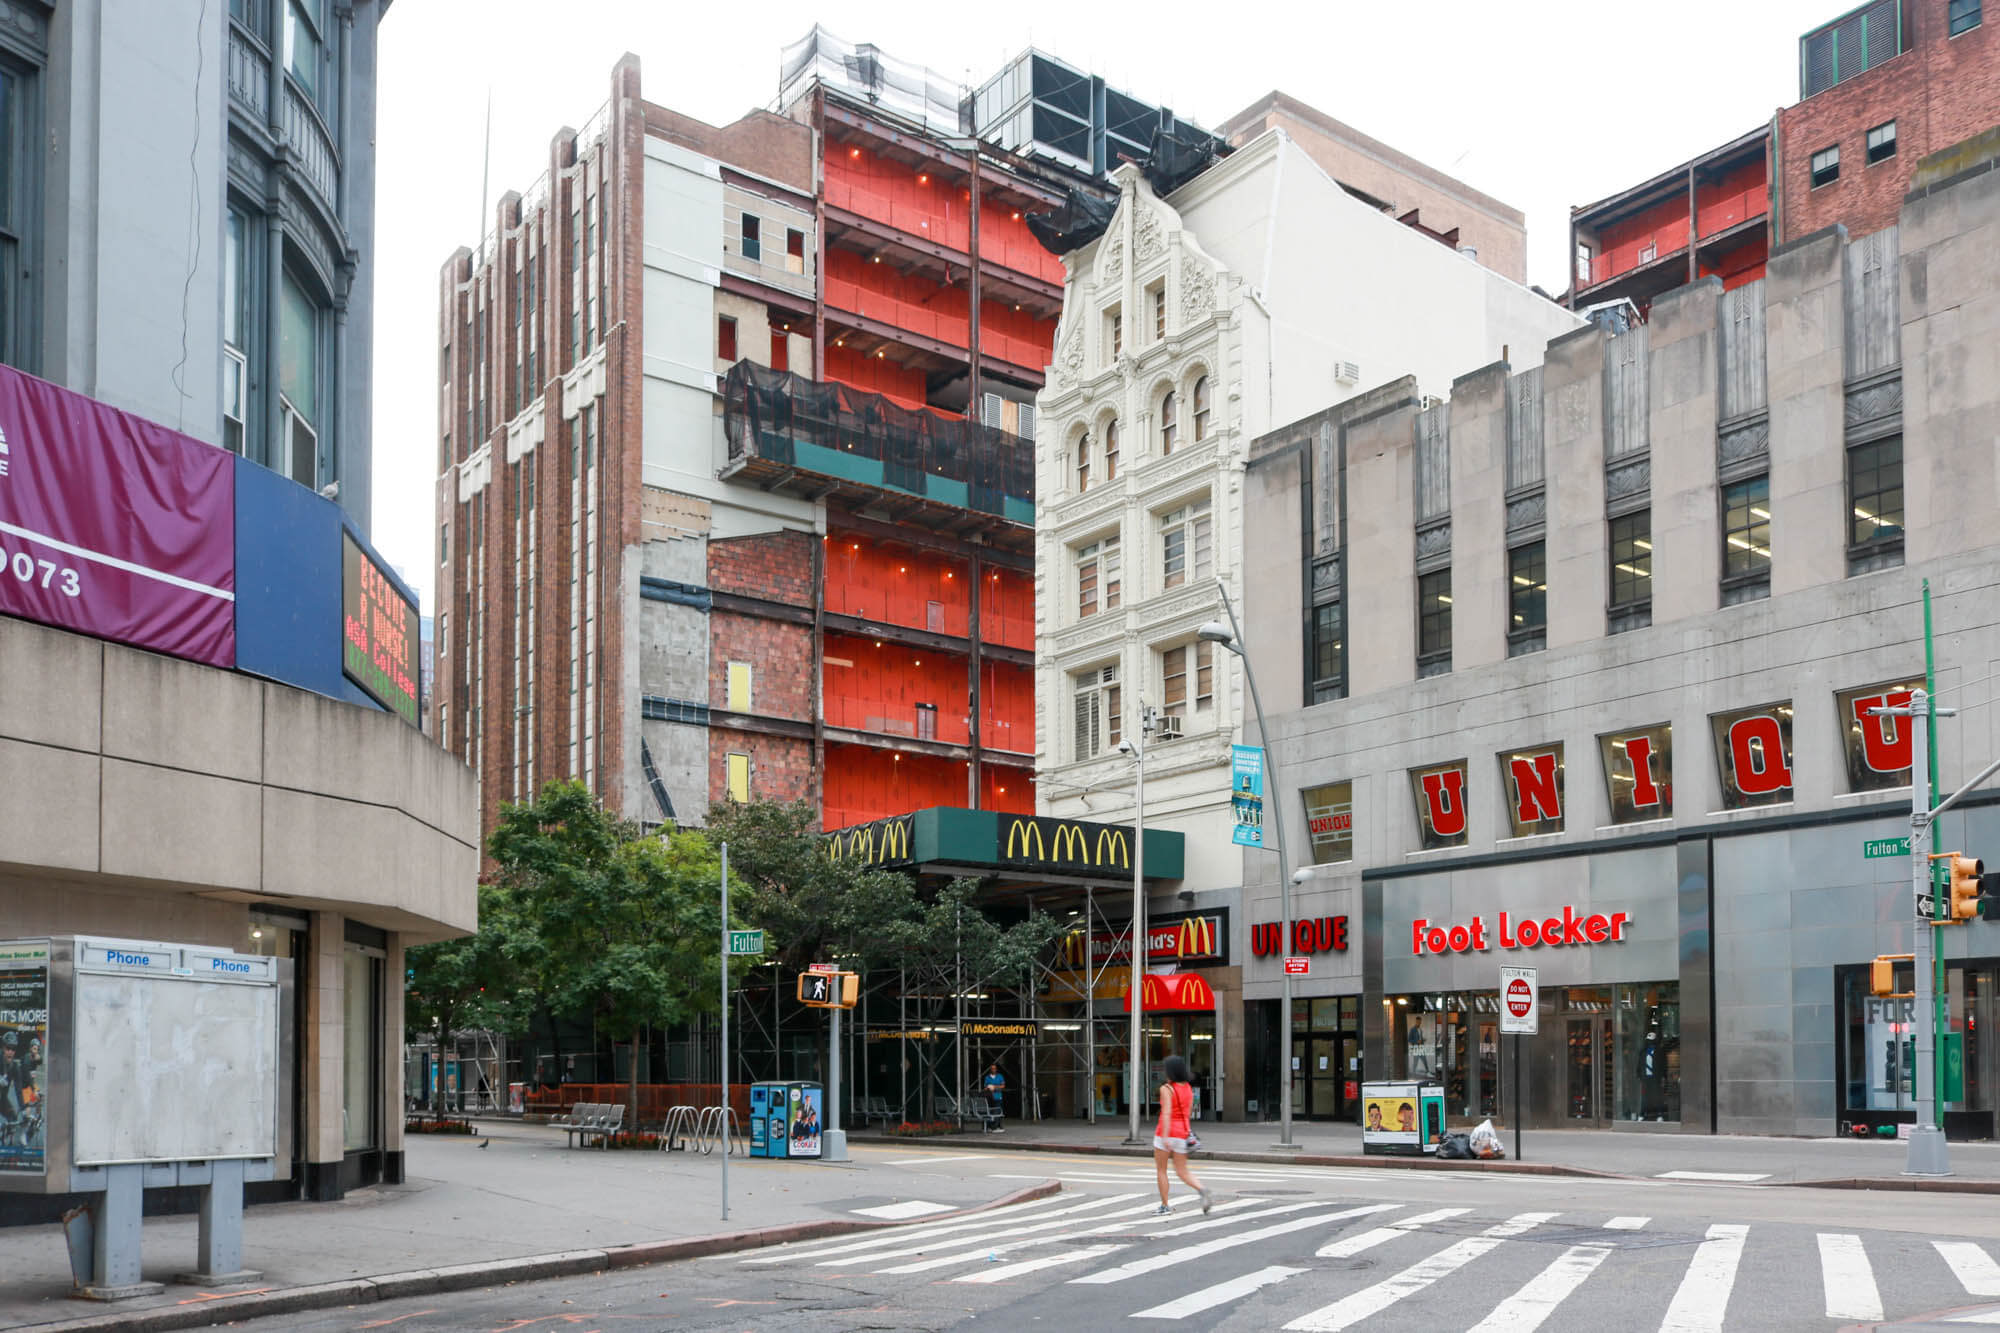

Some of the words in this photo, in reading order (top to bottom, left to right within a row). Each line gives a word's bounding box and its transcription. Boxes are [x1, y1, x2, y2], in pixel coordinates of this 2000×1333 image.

[1867, 842, 1898, 856] Fulton
[1251, 915, 1348, 957] UNIQUE
[1412, 916, 1487, 955] Foot
[1499, 905, 1631, 949] Locker
[106, 950, 150, 966] Phone
[212, 957, 250, 973] Phone
[1510, 985, 1518, 993] DO
[1518, 985, 1528, 993] NOT
[1511, 1003, 1527, 1011] ENTER
[0, 1010, 17, 1023] IT'S
[18, 1009, 47, 1023] MORE
[974, 1023, 1025, 1035] McDonald's
